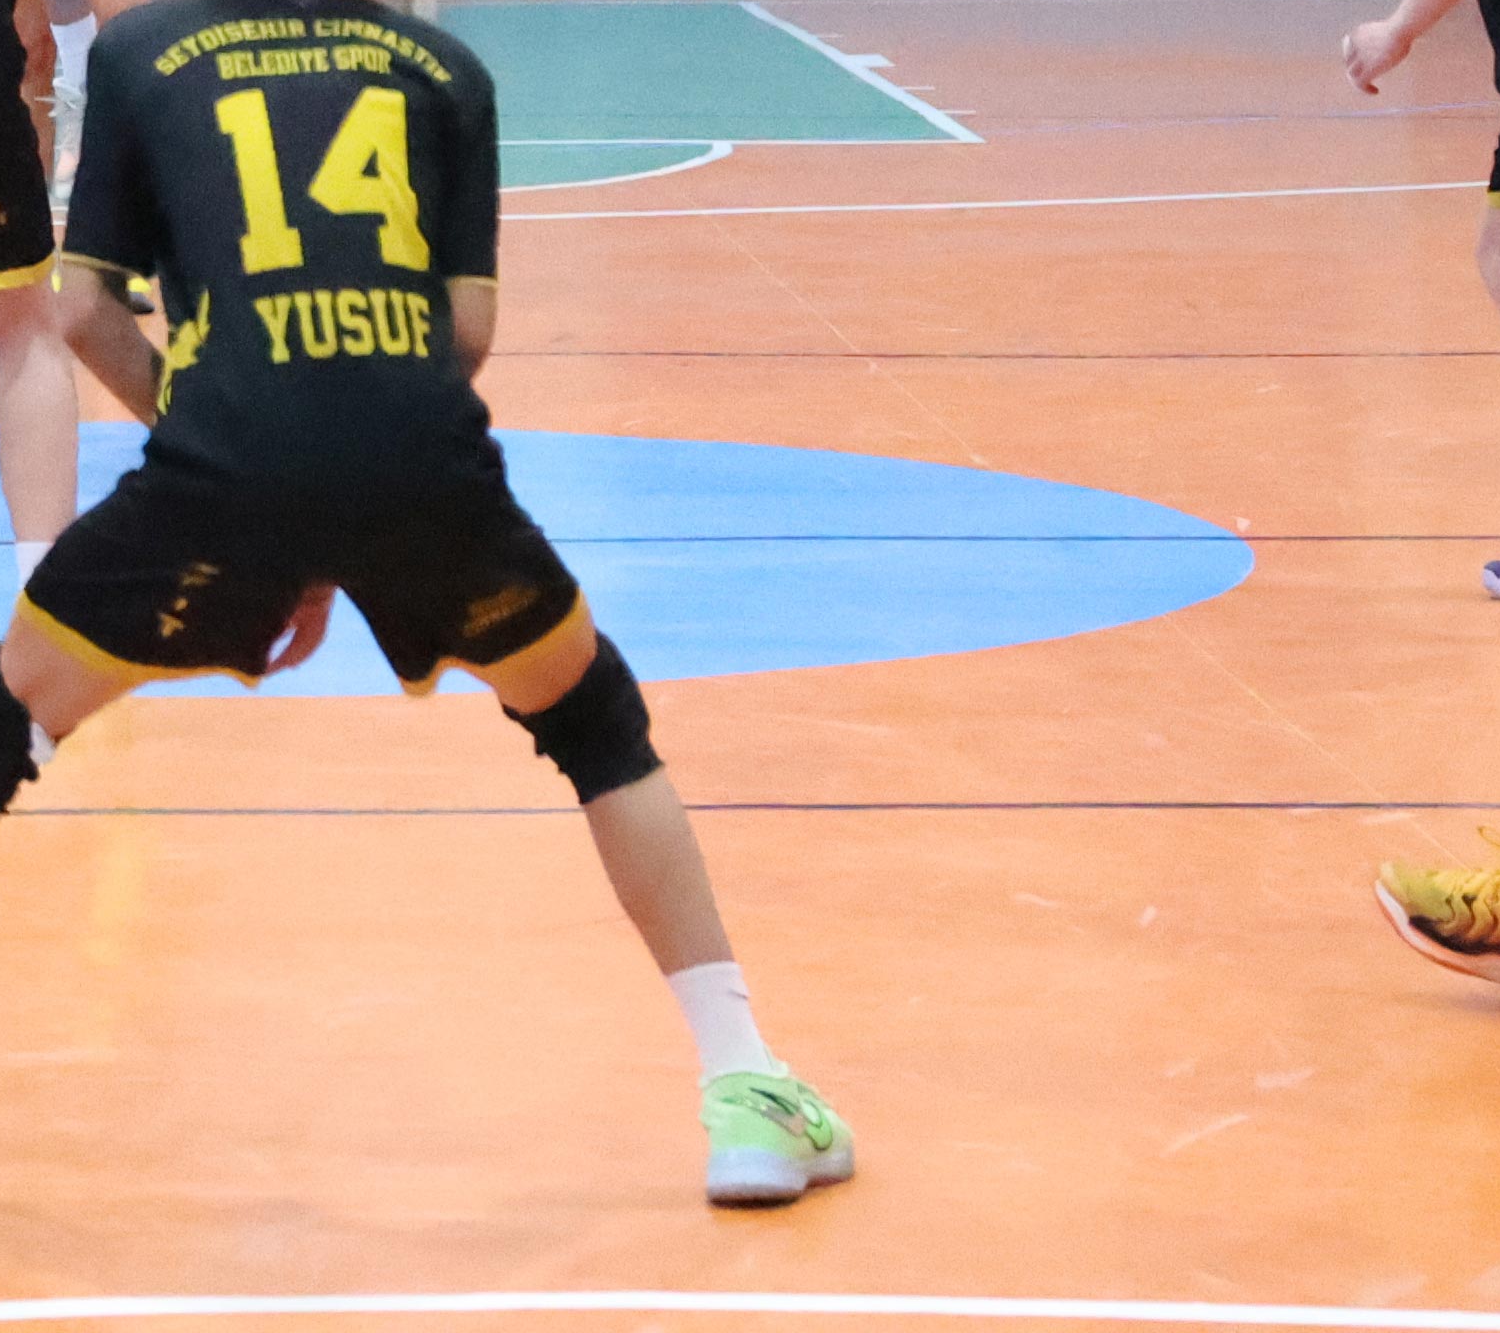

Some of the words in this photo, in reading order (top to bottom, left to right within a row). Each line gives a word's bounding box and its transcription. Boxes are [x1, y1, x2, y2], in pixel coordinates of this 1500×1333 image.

[331, 43, 392, 75] SPOR
[213, 85, 431, 275] 14
[253, 287, 431, 365] YUSUF
